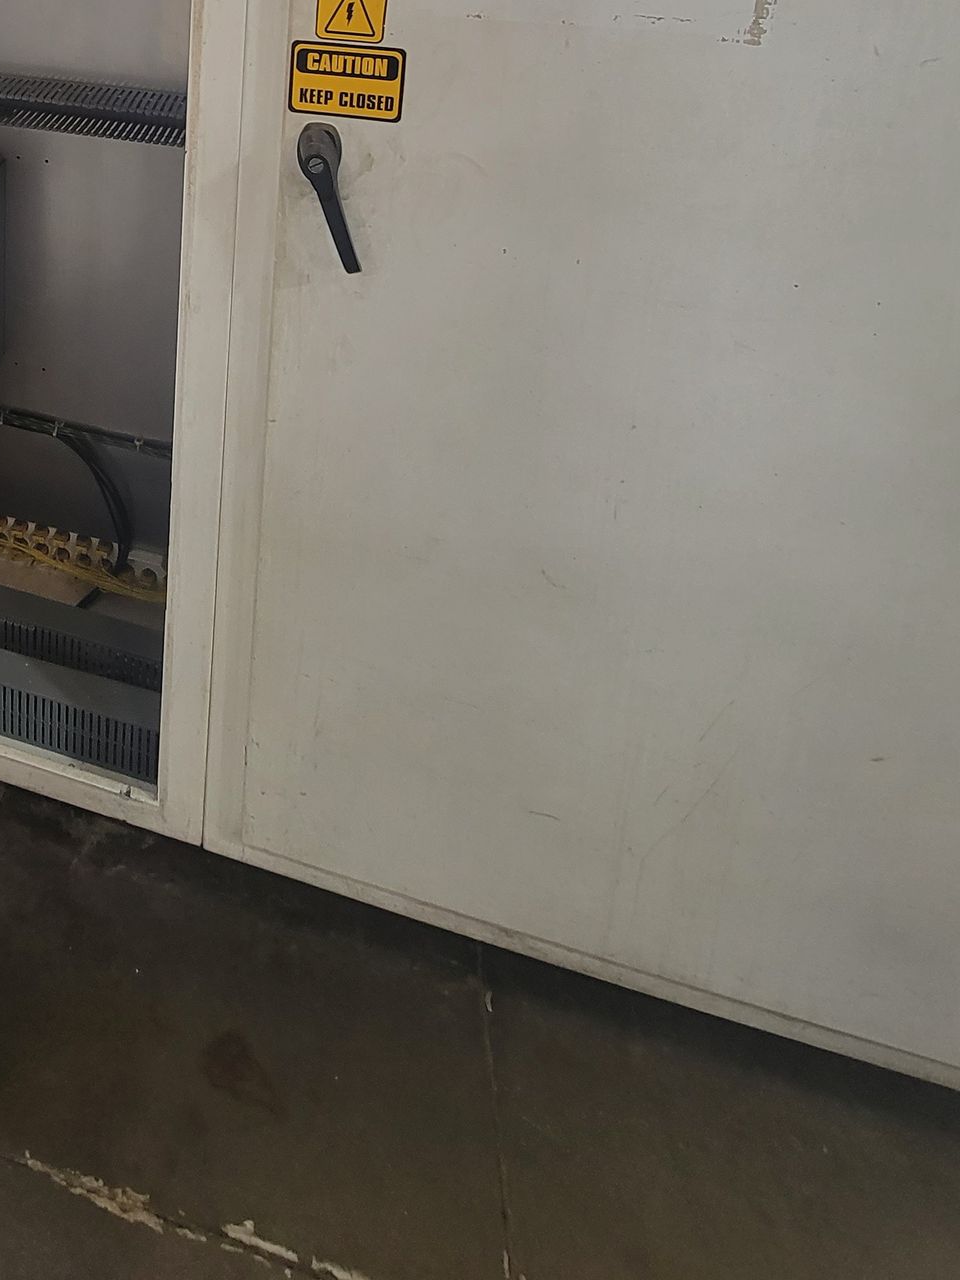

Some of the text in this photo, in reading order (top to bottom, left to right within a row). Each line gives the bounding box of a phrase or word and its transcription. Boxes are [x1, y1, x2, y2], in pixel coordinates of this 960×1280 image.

[306, 52, 389, 77] CAUTION
[299, 87, 395, 112] KEEP CLOSED
